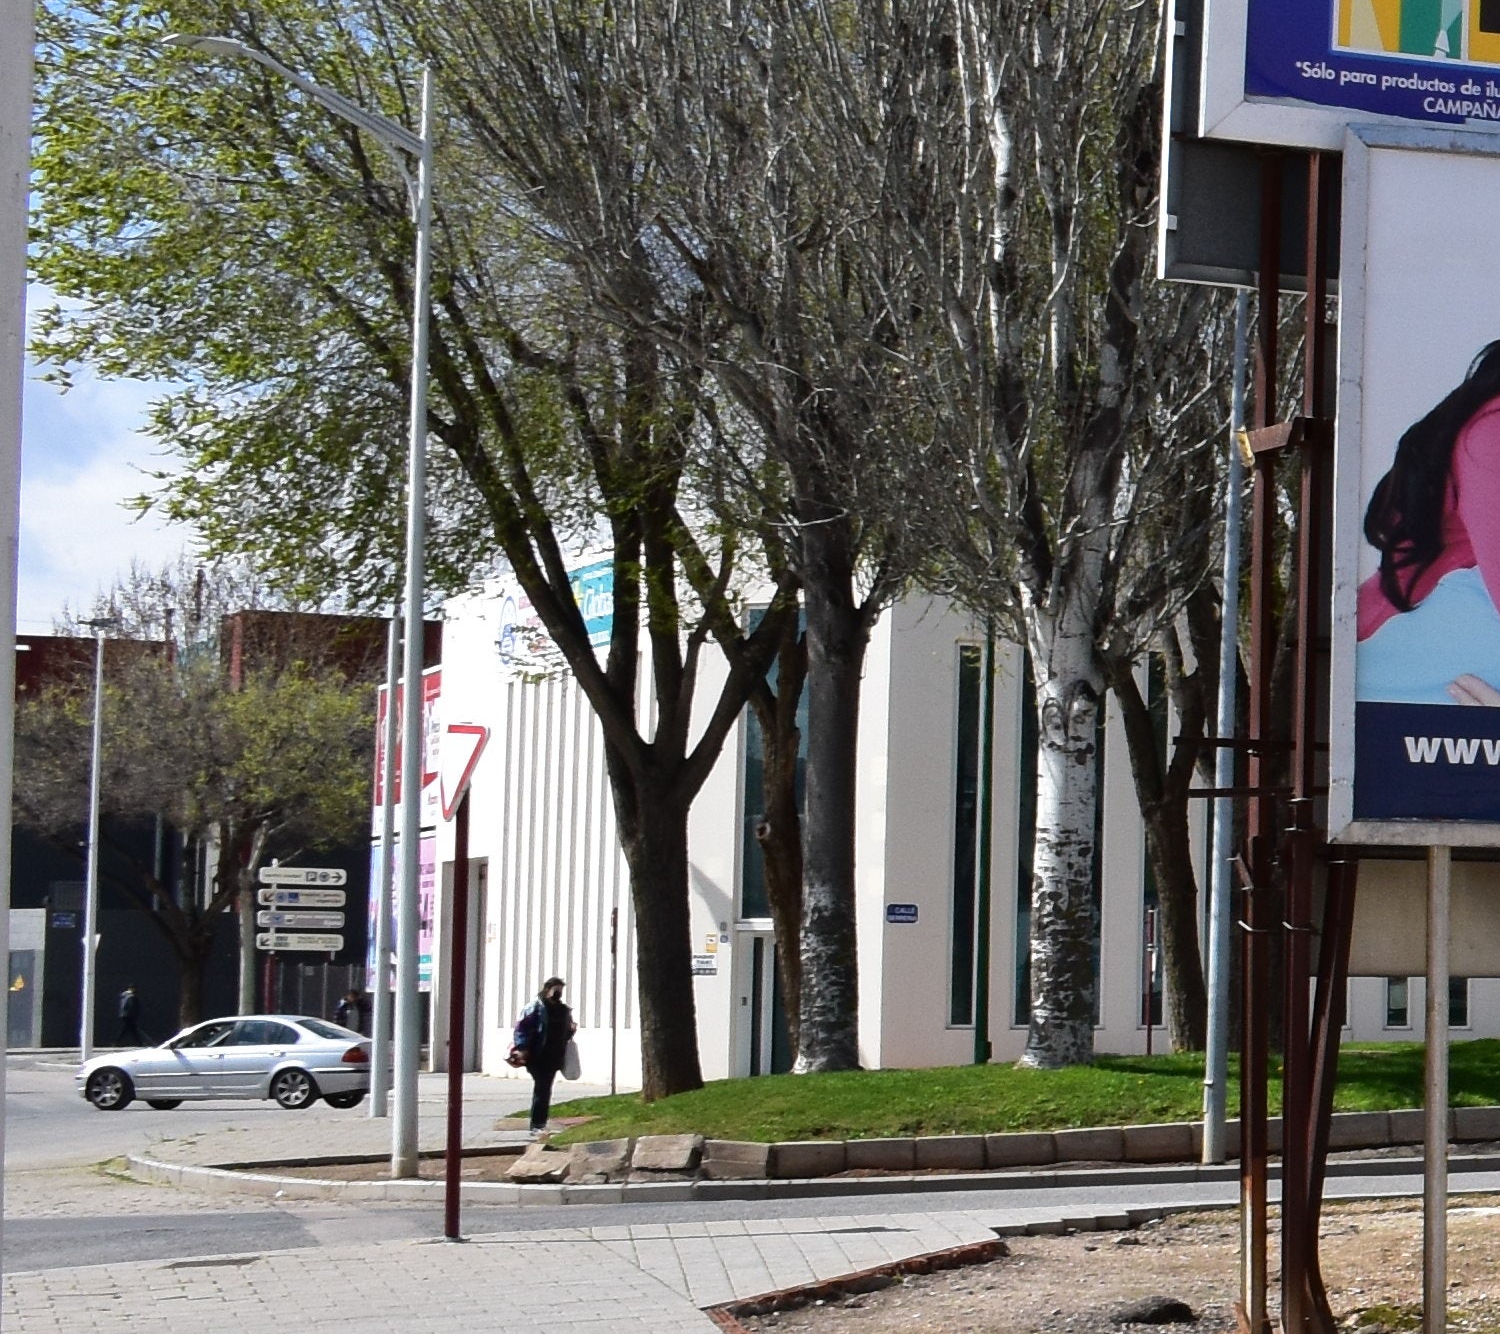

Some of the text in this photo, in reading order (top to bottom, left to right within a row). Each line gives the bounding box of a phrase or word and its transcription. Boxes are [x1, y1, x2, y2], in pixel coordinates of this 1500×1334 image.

[1340, 70, 1377, 87] para
[1382, 72, 1456, 95] productos
[1460, 78, 1482, 96] de
